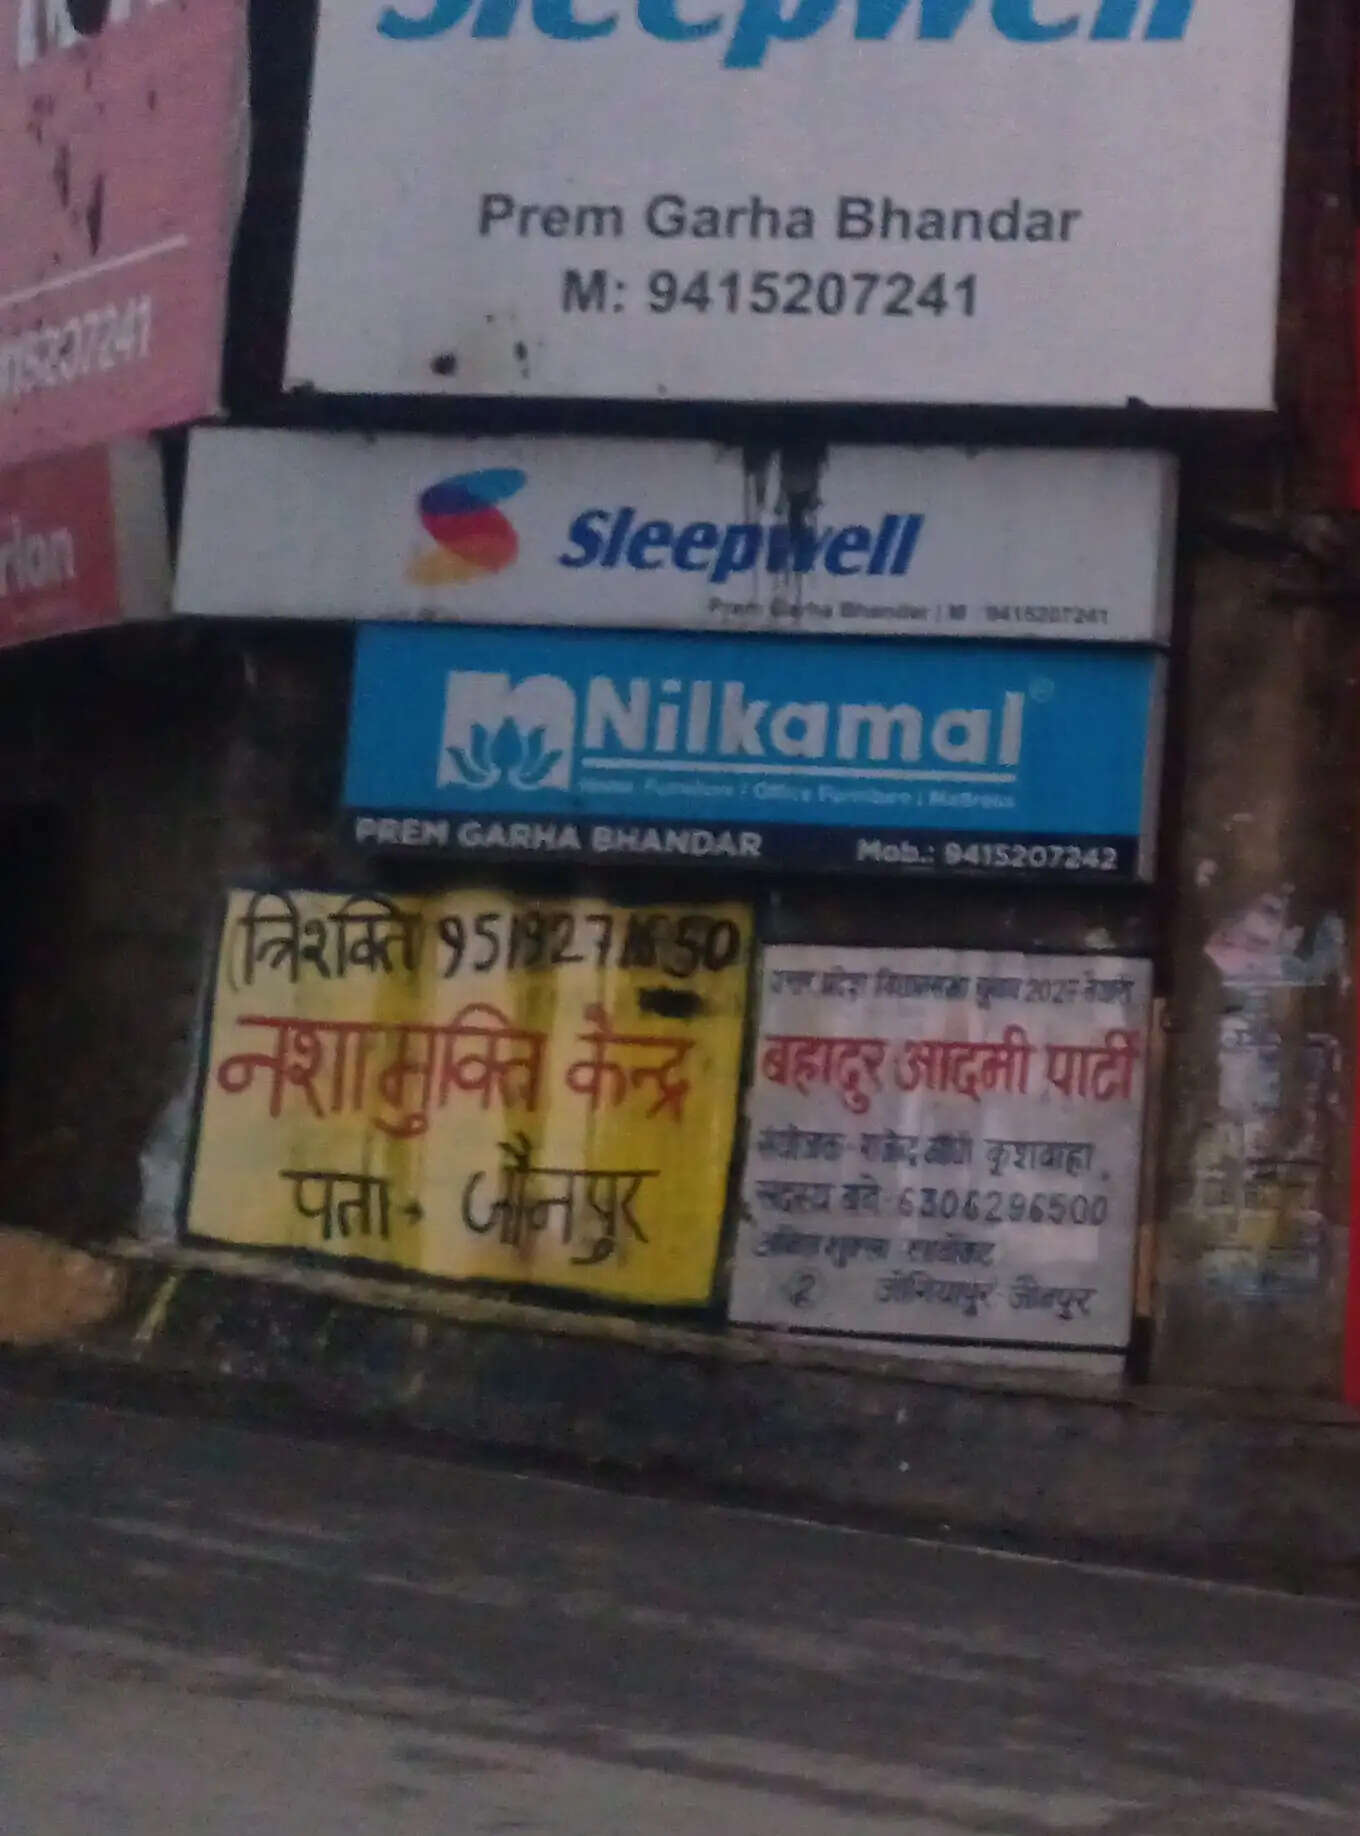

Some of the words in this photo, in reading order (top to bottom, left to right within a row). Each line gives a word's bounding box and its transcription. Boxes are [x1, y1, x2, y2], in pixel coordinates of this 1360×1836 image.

[479, 195, 622, 241] Prem
[647, 196, 813, 242] Garha
[837, 198, 1081, 245] Bhandar
[562, 271, 626, 314] M:
[648, 271, 979, 317] 9415207241
[558, 506, 925, 584] Sleepwell
[583, 675, 1025, 767] Nilkamal
[355, 816, 450, 847] PREM
[457, 820, 582, 851] GARHA
[591, 825, 764, 858] BHANDAR
[945, 841, 1119, 872] 9415207242
[761, 1033, 888, 1115] बहादुर
[895, 1024, 1036, 1103] आदमी
[1043, 1027, 1141, 1100] पार्टी
